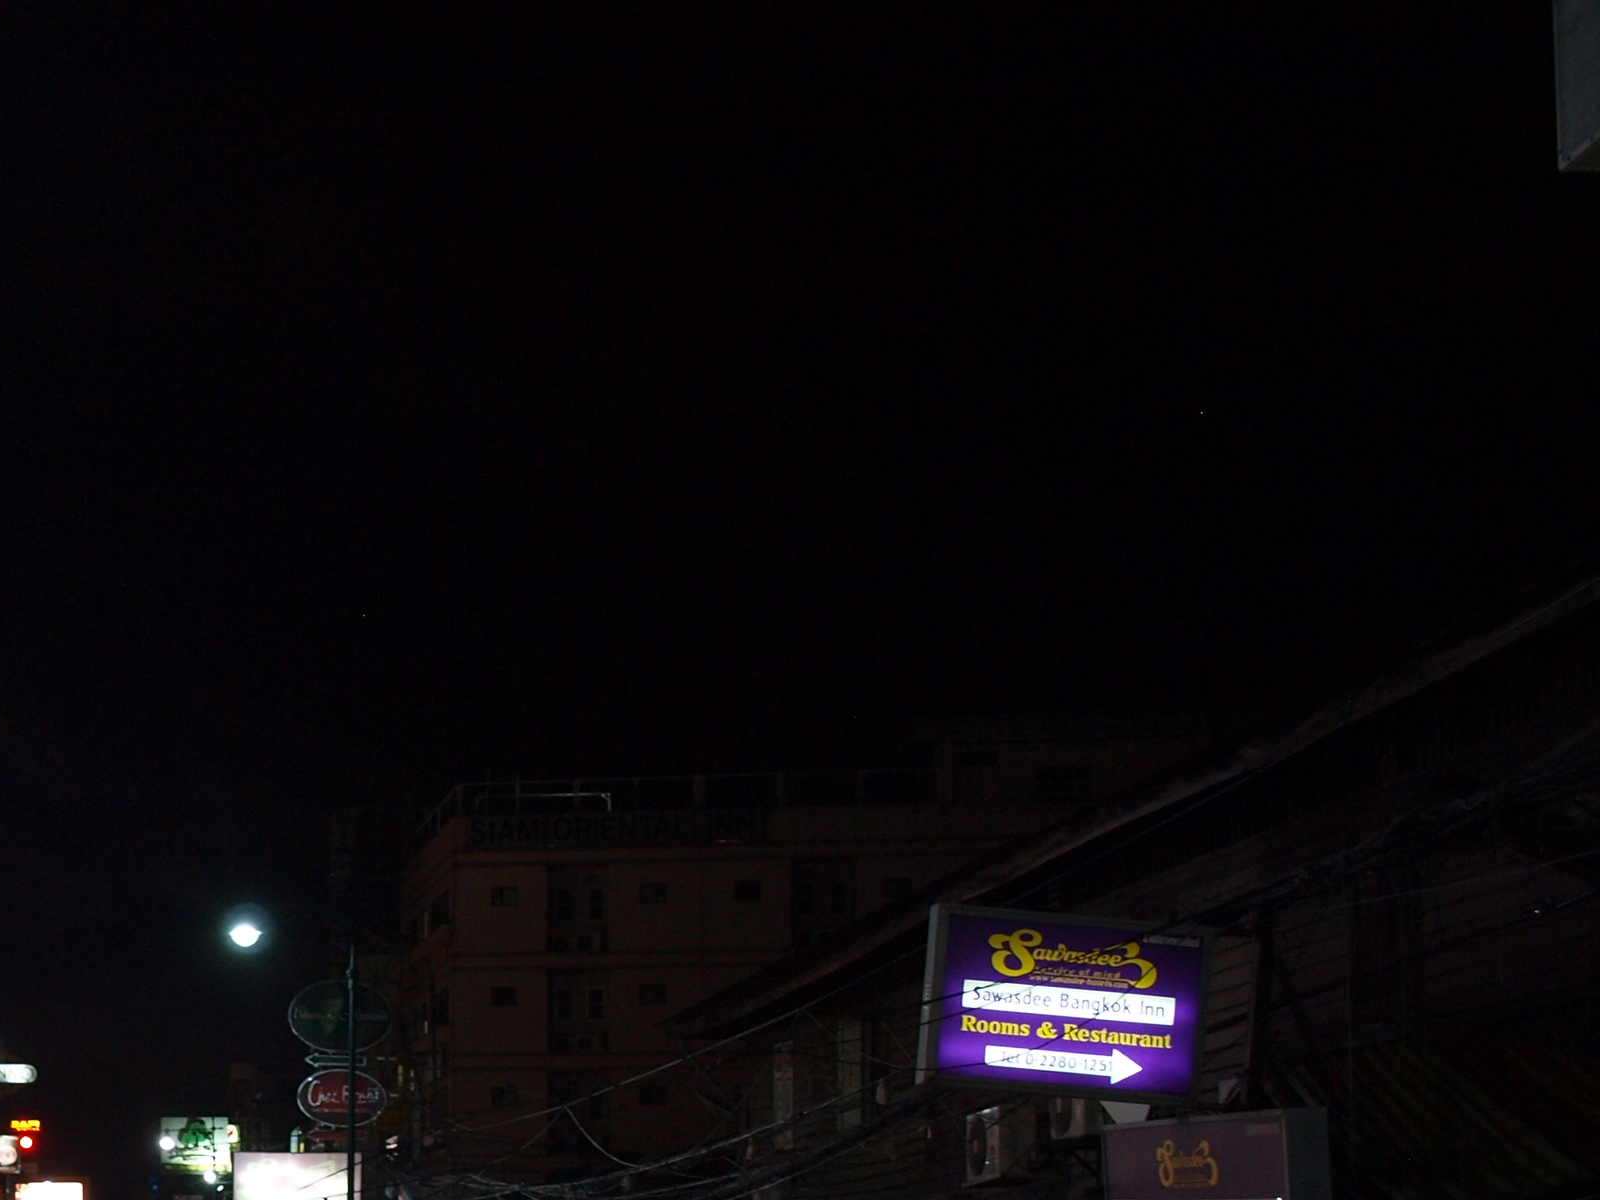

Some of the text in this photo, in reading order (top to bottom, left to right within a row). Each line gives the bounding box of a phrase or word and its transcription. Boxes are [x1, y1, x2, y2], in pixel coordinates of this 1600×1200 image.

[468, 817, 542, 845] SIAM
[973, 986, 1165, 1018] Sawasdee Bangkok Inn
[961, 1014, 1173, 1049] Rooms & Restaurant
[1025, 1053, 1113, 1073] 0-2280-1251
